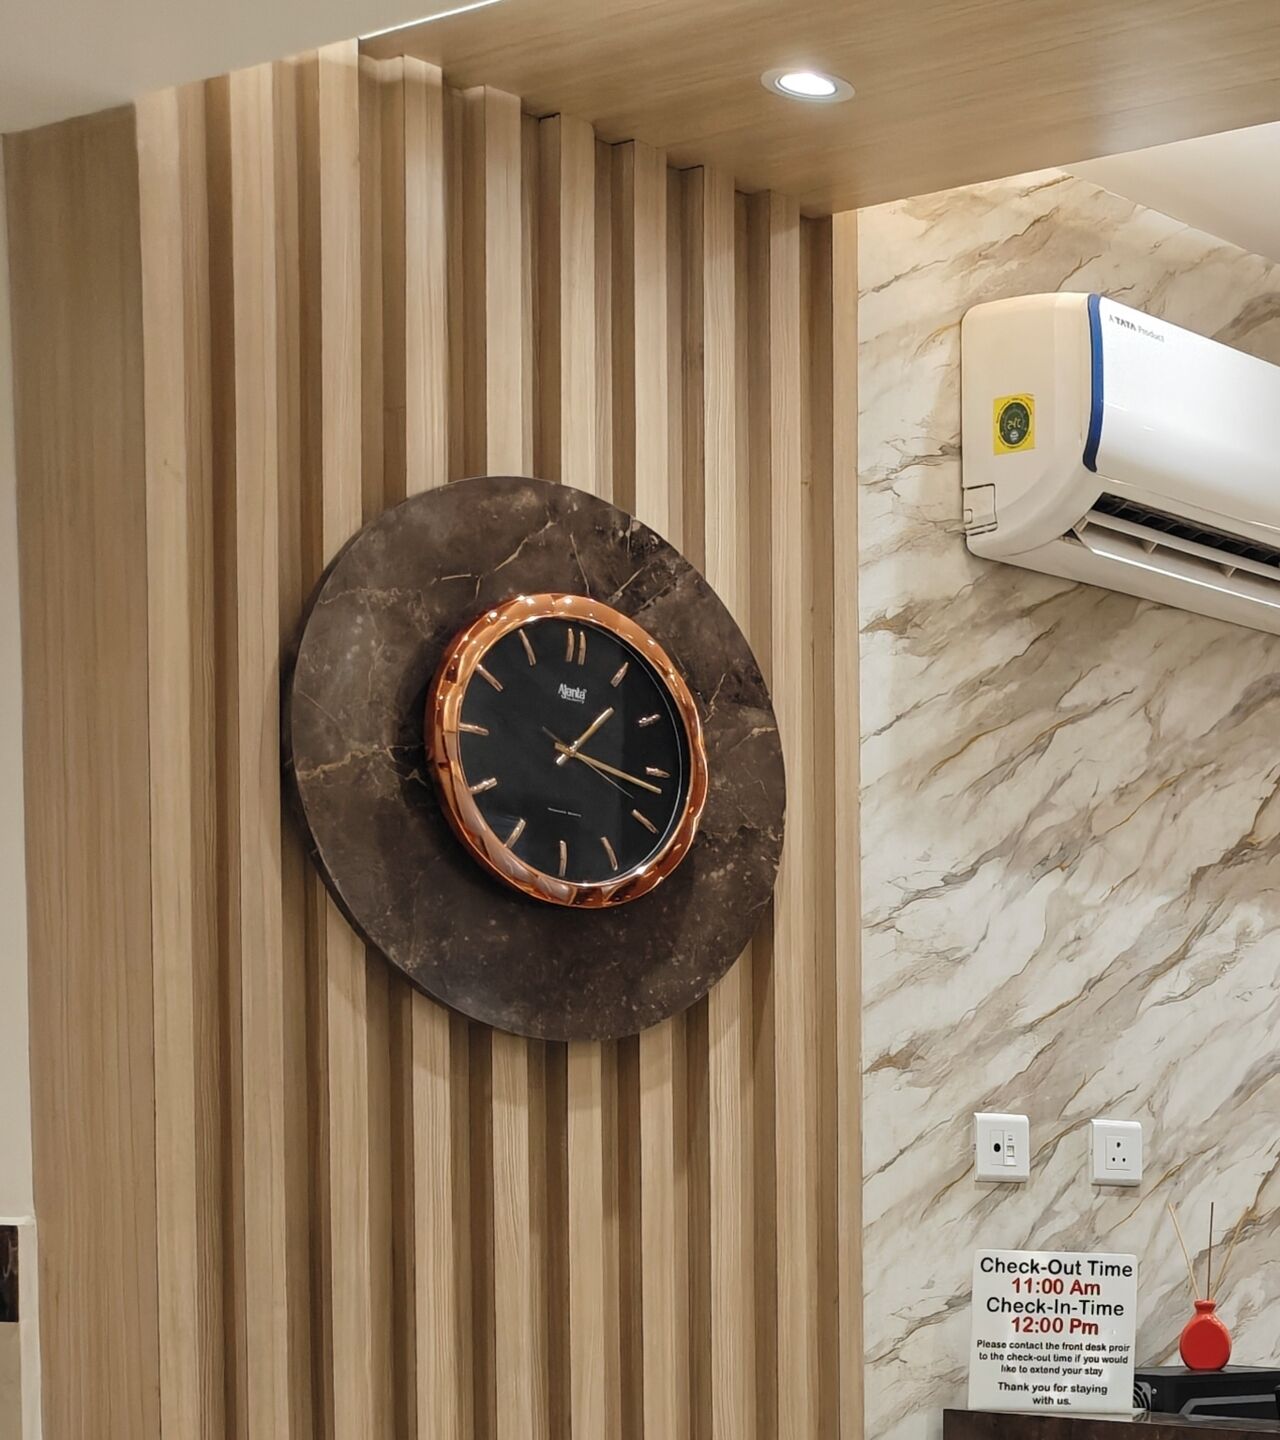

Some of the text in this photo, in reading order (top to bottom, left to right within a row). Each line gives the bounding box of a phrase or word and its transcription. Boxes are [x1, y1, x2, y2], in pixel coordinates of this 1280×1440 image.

[1115, 316, 1136, 331] TATA
[558, 683, 586, 699] Ajanta
[981, 1257, 1132, 1277] Check-Out Time
[1012, 1277, 1100, 1295] 11:00 Am
[986, 1297, 1124, 1316] Check-In-Time
[1012, 1317, 1098, 1335] 12:00 Pm
[977, 1340, 1006, 1348] Please
[1009, 1341, 1043, 1350] contact
[1046, 1342, 1059, 1350] the
[1062, 1342, 1083, 1351] front
[1085, 1343, 1106, 1351] desk
[990, 1352, 1004, 1360] the
[1007, 1353, 1051, 1362] check-out
[1053, 1354, 1072, 1362] time
[1075, 1354, 1080, 1363] if
[1083, 1356, 1100, 1364] you
[1101, 1356, 1128, 1364] would
[1001, 1365, 1103, 1377] like to extend your stay
[998, 1382, 1107, 1395] Thank you for staying
[1032, 1397, 1054, 1405] with
